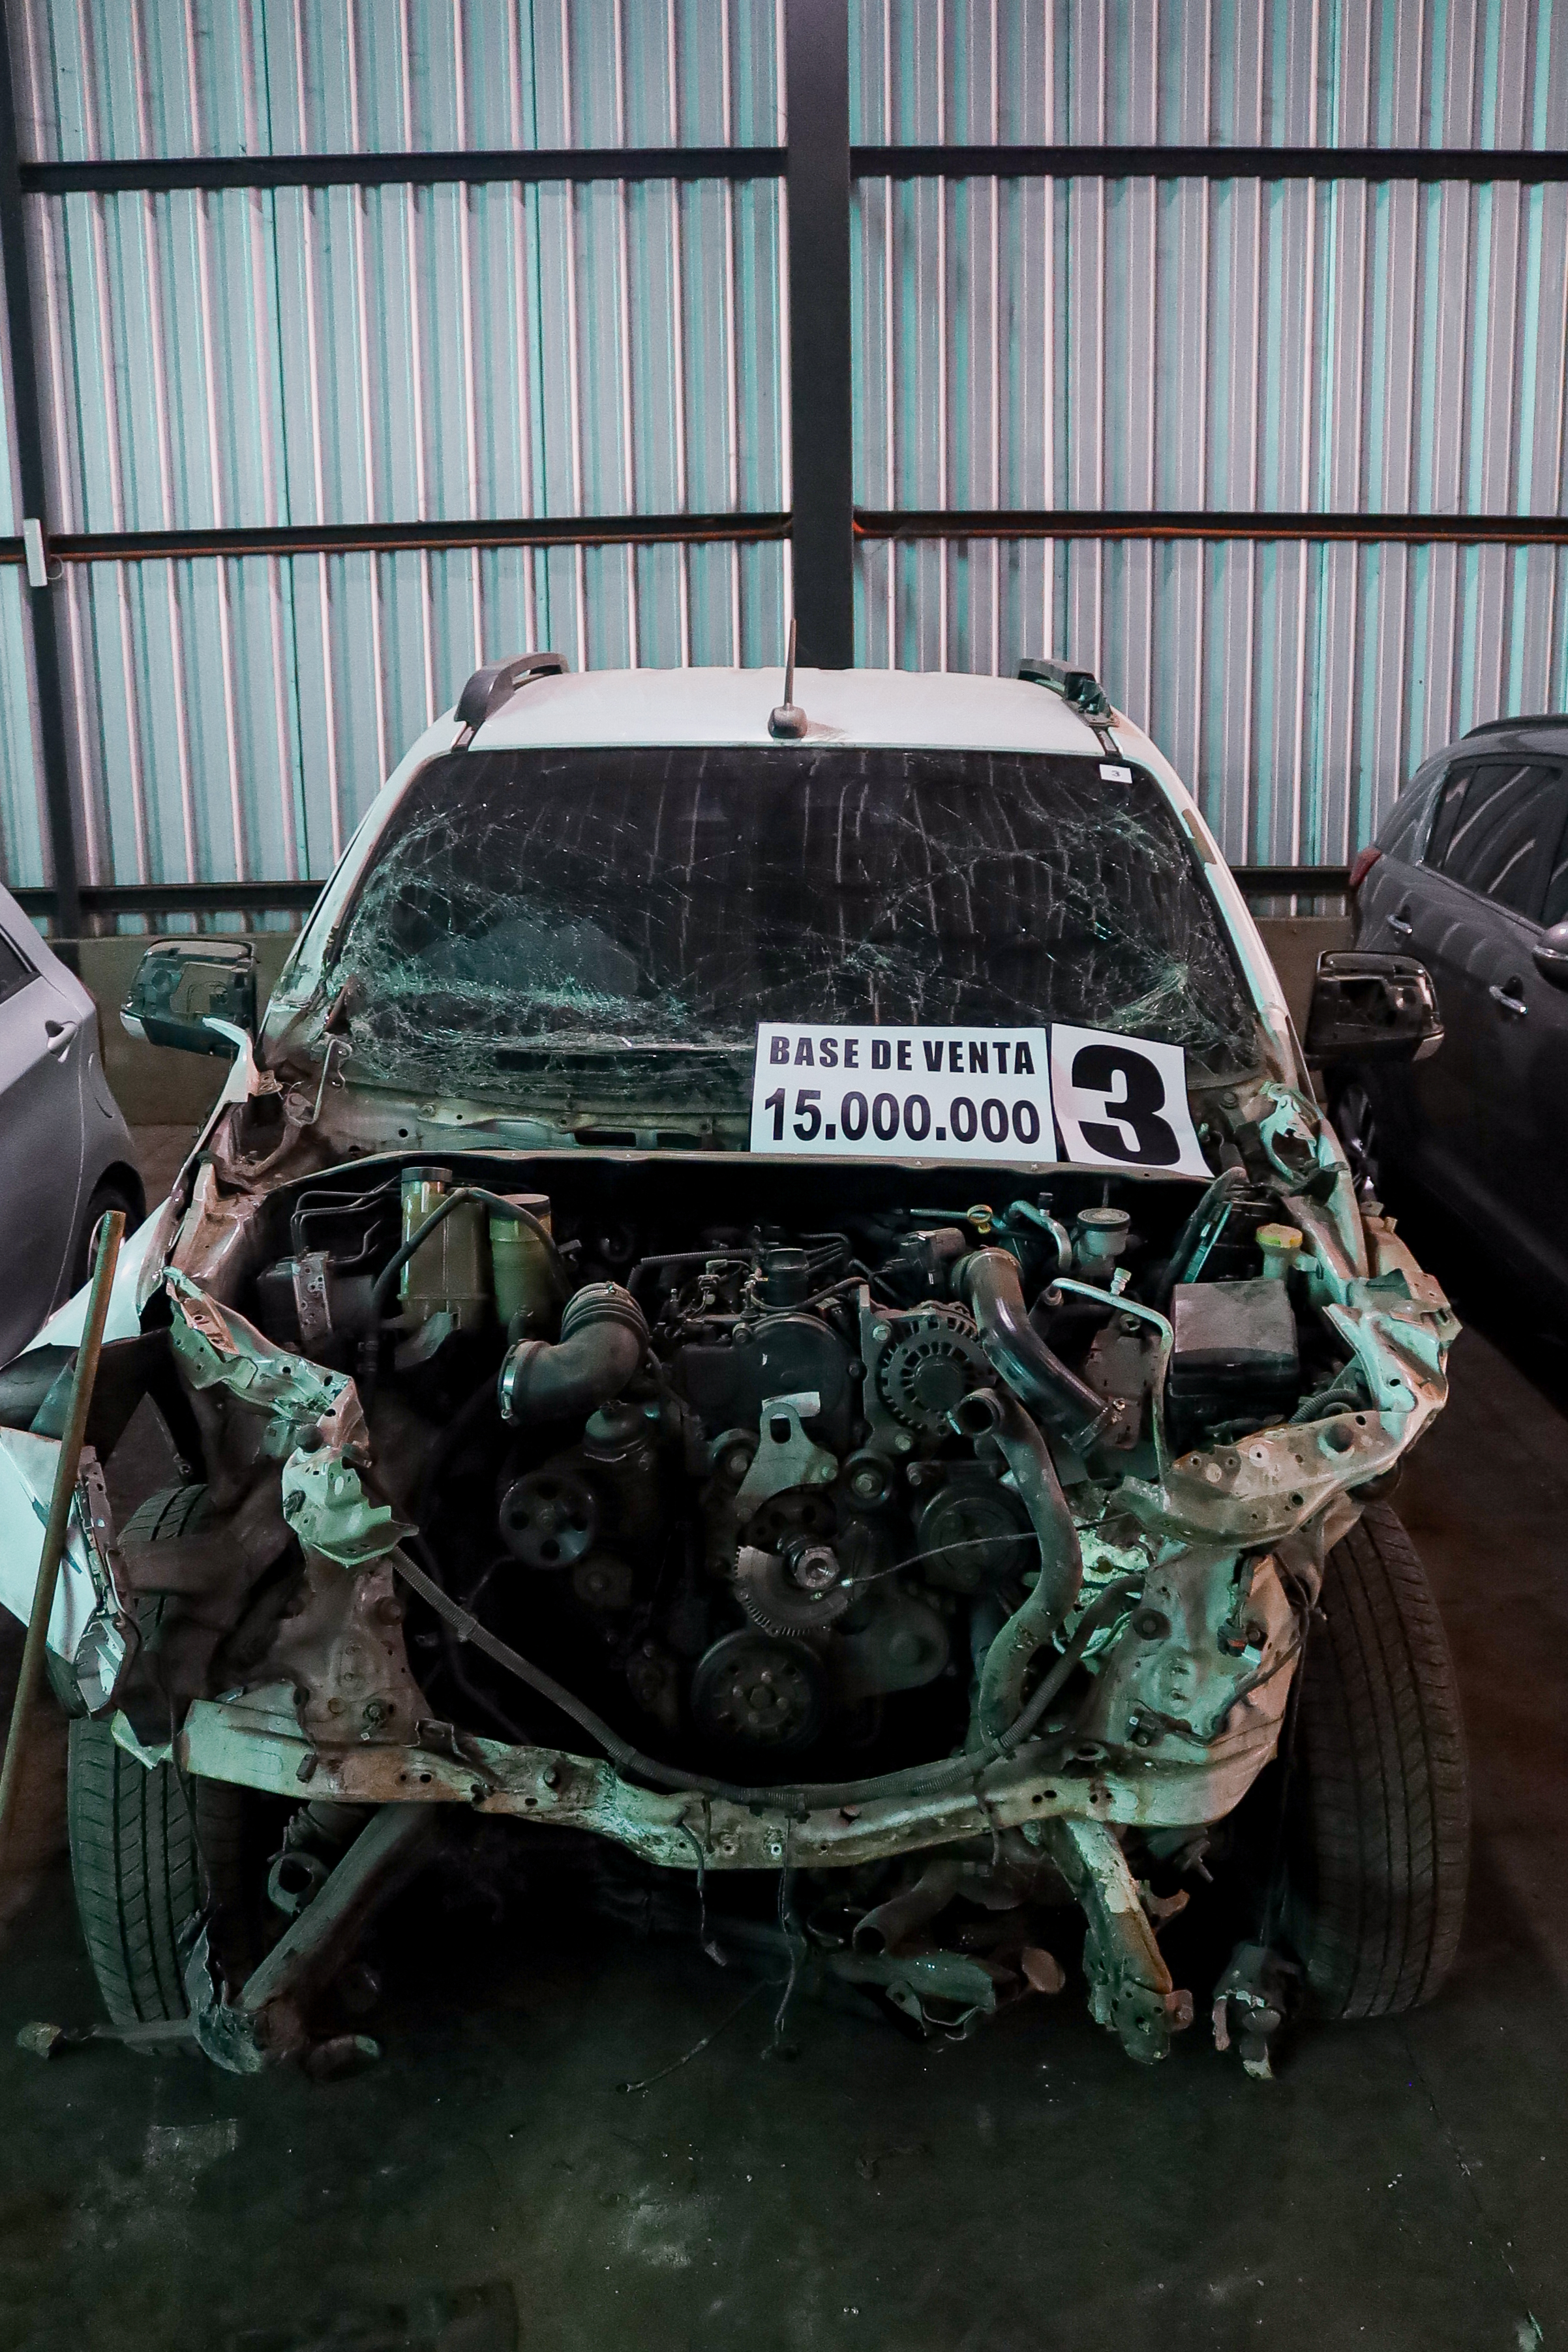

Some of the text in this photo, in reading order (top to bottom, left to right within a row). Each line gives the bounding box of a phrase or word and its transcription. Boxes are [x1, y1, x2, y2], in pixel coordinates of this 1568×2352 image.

[770, 1036, 1035, 1075] BASE DE VENTA
[764, 1088, 1040, 1145] 15.000.000
[1071, 1044, 1181, 1166] 3
